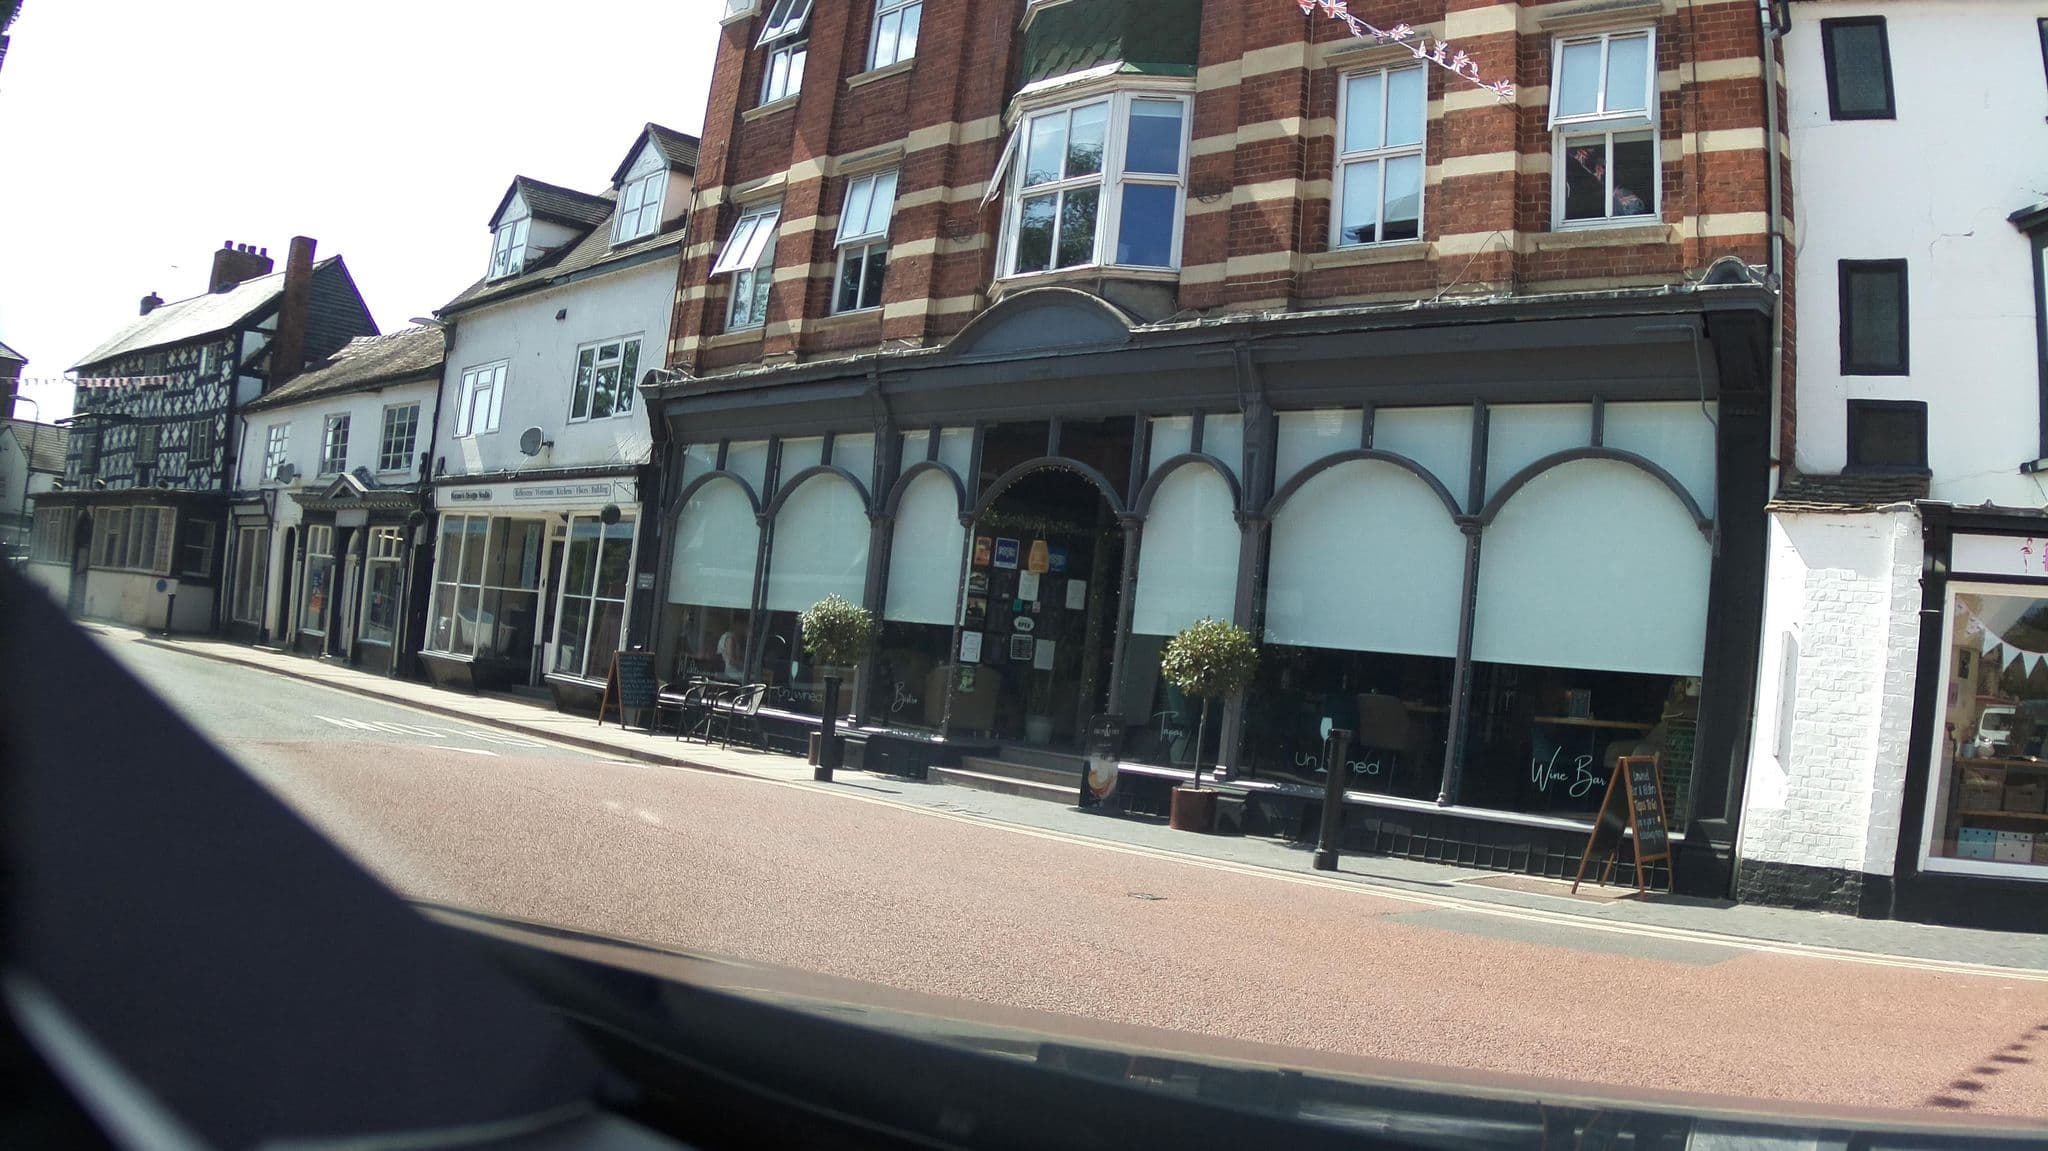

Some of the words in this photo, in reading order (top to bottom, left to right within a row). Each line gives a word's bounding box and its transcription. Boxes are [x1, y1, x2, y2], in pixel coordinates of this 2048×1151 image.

[1152, 711, 1184, 744] Tapas
[1531, 745, 1568, 792] Wine
[1569, 755, 1606, 798] Bar
